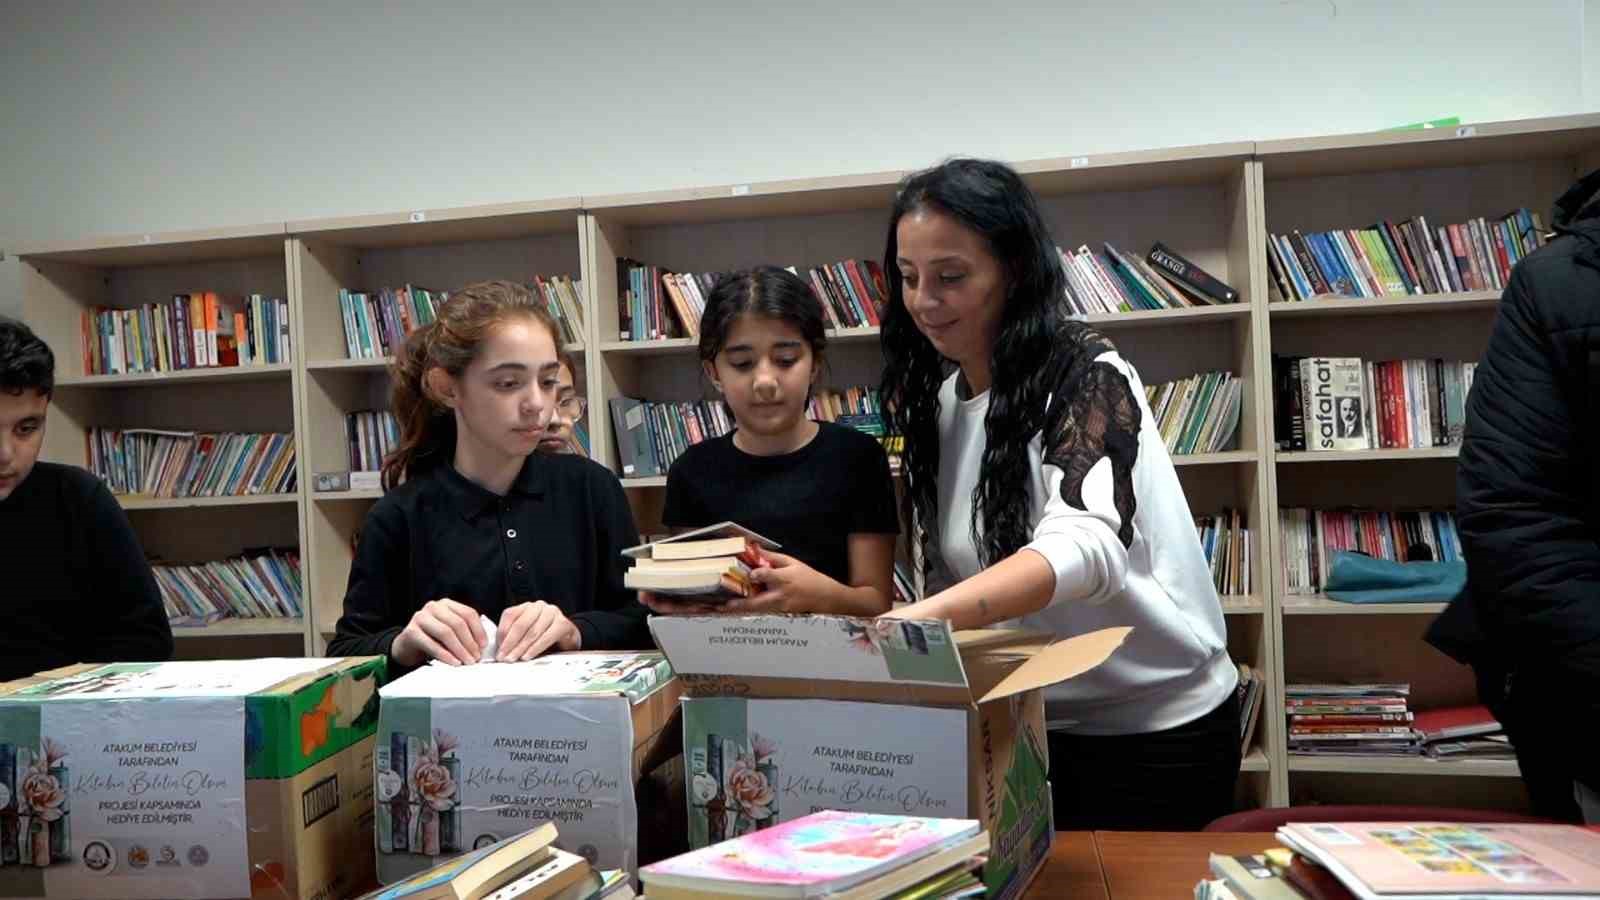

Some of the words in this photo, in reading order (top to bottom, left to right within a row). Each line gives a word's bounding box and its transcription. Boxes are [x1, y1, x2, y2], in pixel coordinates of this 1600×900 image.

[1313, 358, 1334, 448] safahat
[103, 743, 144, 753] ATAKUM
[144, 741, 198, 753] BELEDİYESİ
[493, 737, 533, 750] ATAKUM
[534, 739, 588, 751] BELEDİYESİ
[510, 752, 569, 764] TARAFINDAN
[813, 746, 855, 759] ATAKUM
[856, 750, 914, 765] BELEDİYESİ
[118, 757, 180, 768] TARAFINDAN
[830, 762, 894, 777] TARAFINDAN
[139, 799, 202, 811] KAPSAMINDA
[106, 812, 141, 825] HEDİYE
